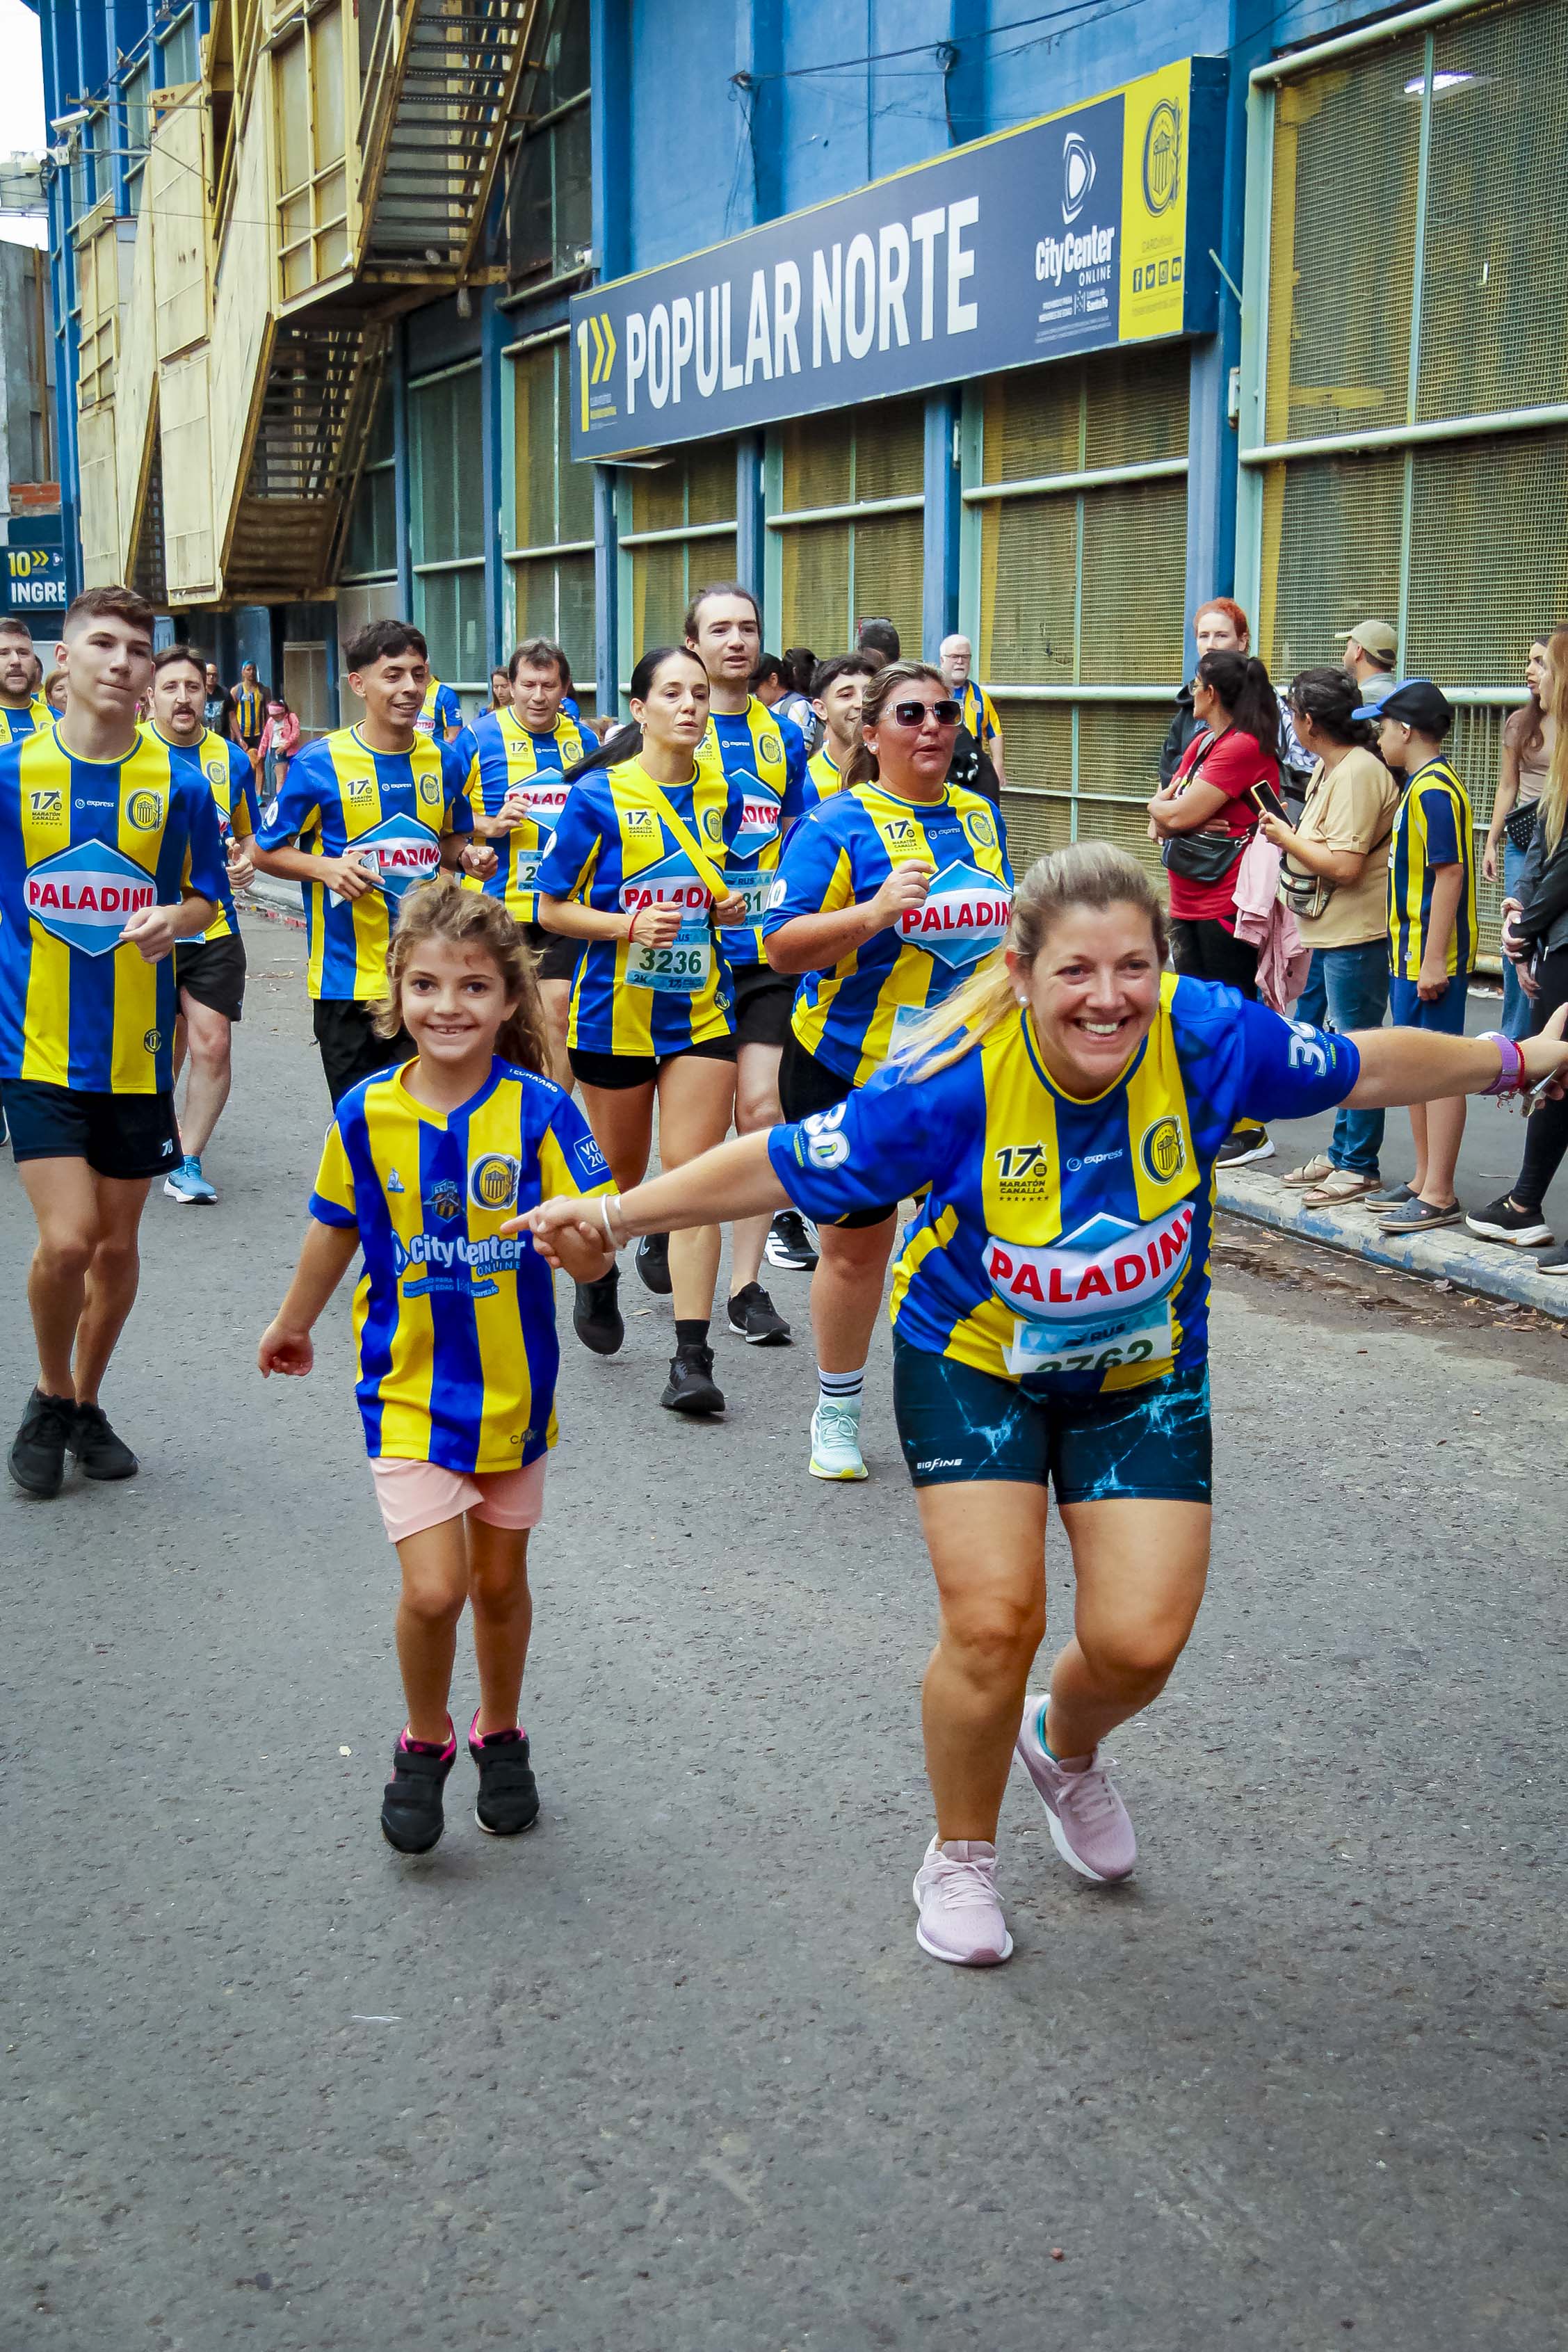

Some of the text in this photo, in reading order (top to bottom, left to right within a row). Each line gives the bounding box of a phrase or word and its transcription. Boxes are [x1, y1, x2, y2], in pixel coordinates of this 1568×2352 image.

[1079, 265, 1112, 287] ONLINE
[627, 196, 979, 415] POPULAR NORTE
[8, 551, 31, 577] 10
[11, 582, 65, 603] INGRE
[348, 779, 369, 796] 17
[30, 790, 60, 810] 17
[624, 811, 649, 825] 17
[884, 820, 911, 839] 17
[29, 880, 154, 912] PALADINI
[674, 933, 690, 942] US
[639, 948, 702, 974] 3236
[633, 974, 647, 983] 2K
[996, 1142, 1045, 1177] 17
[1083, 1149, 1124, 1164] express
[477, 1260, 521, 1276] ONLINE
[1090, 1323, 1126, 1342] RUS
[917, 1458, 962, 1472] BIGFINE
